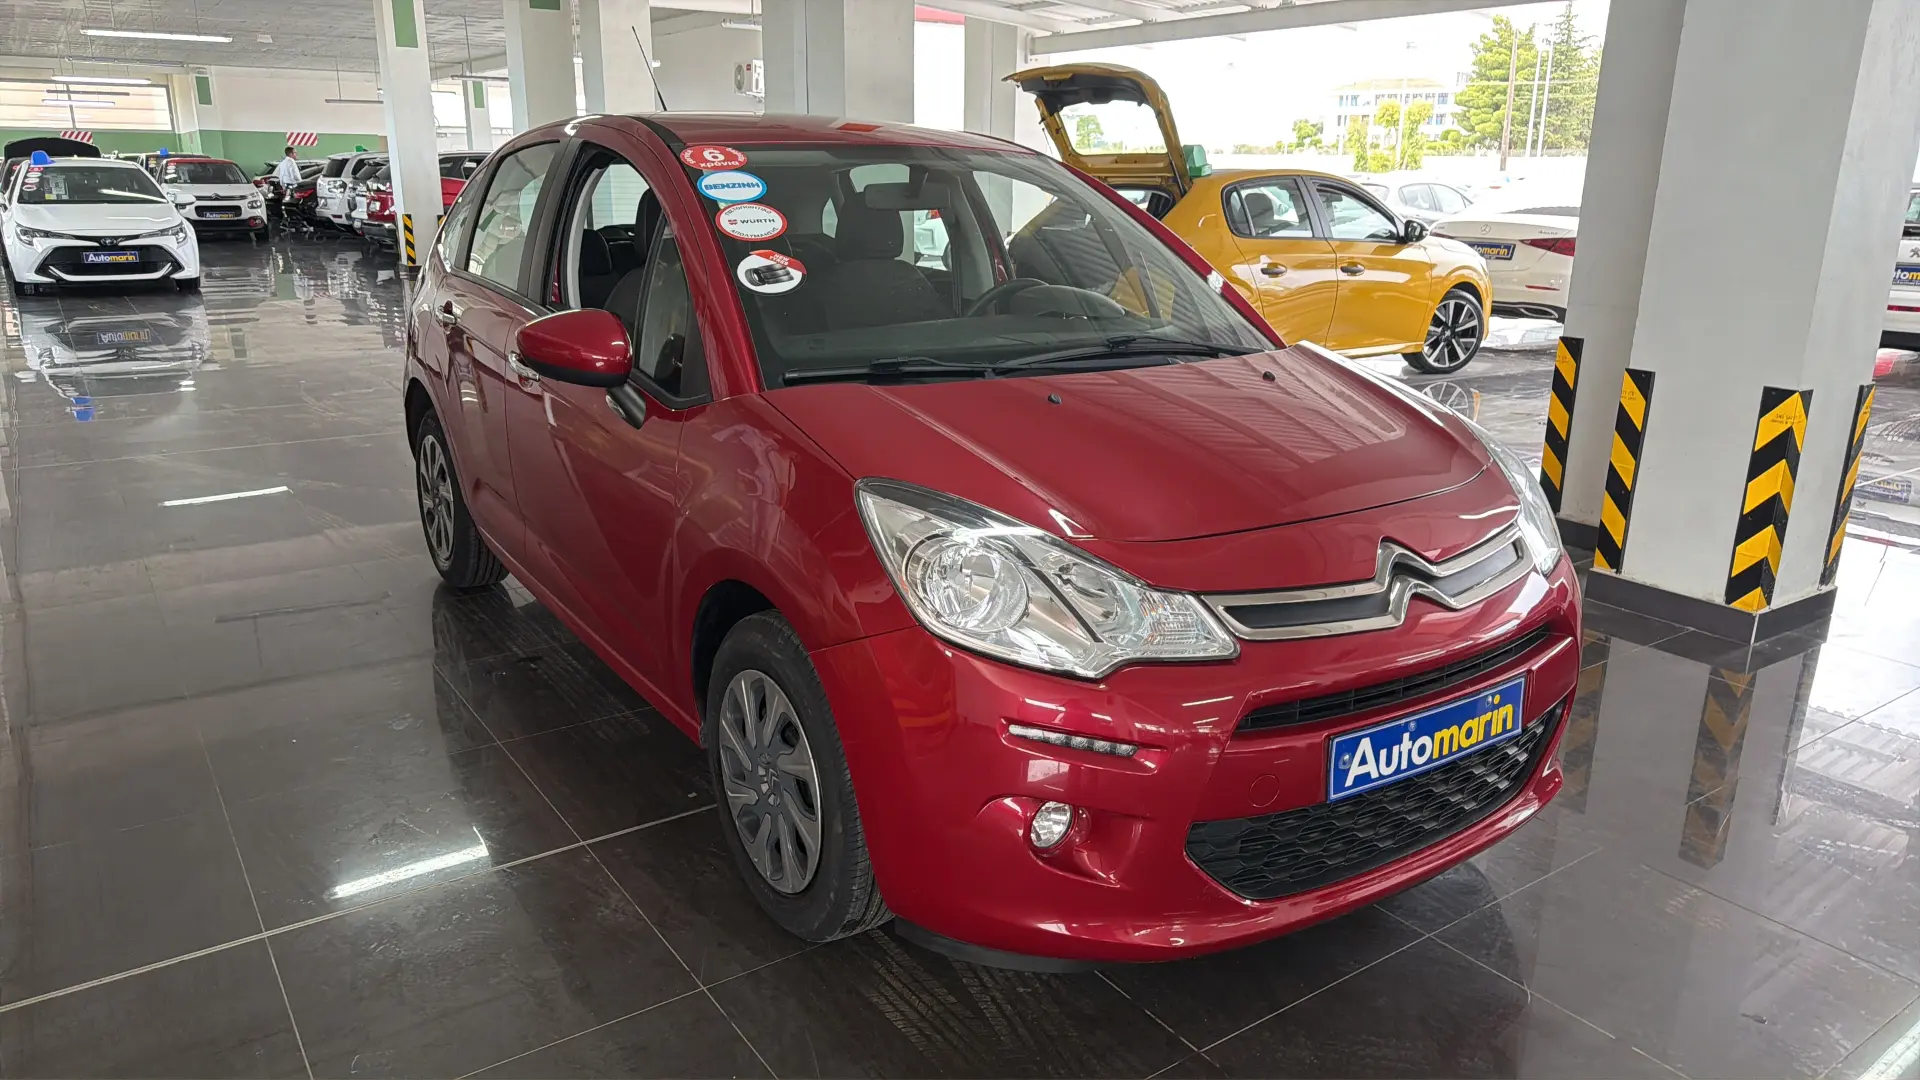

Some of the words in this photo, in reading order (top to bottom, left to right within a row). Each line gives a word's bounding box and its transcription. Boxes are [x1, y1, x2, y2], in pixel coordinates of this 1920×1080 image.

[702, 149, 725, 162] 6
[1473, 244, 1509, 256] tomarin
[88, 252, 136, 262] Automarin
[1892, 268, 1920, 281] tom
[1344, 693, 1514, 788] Automarin
